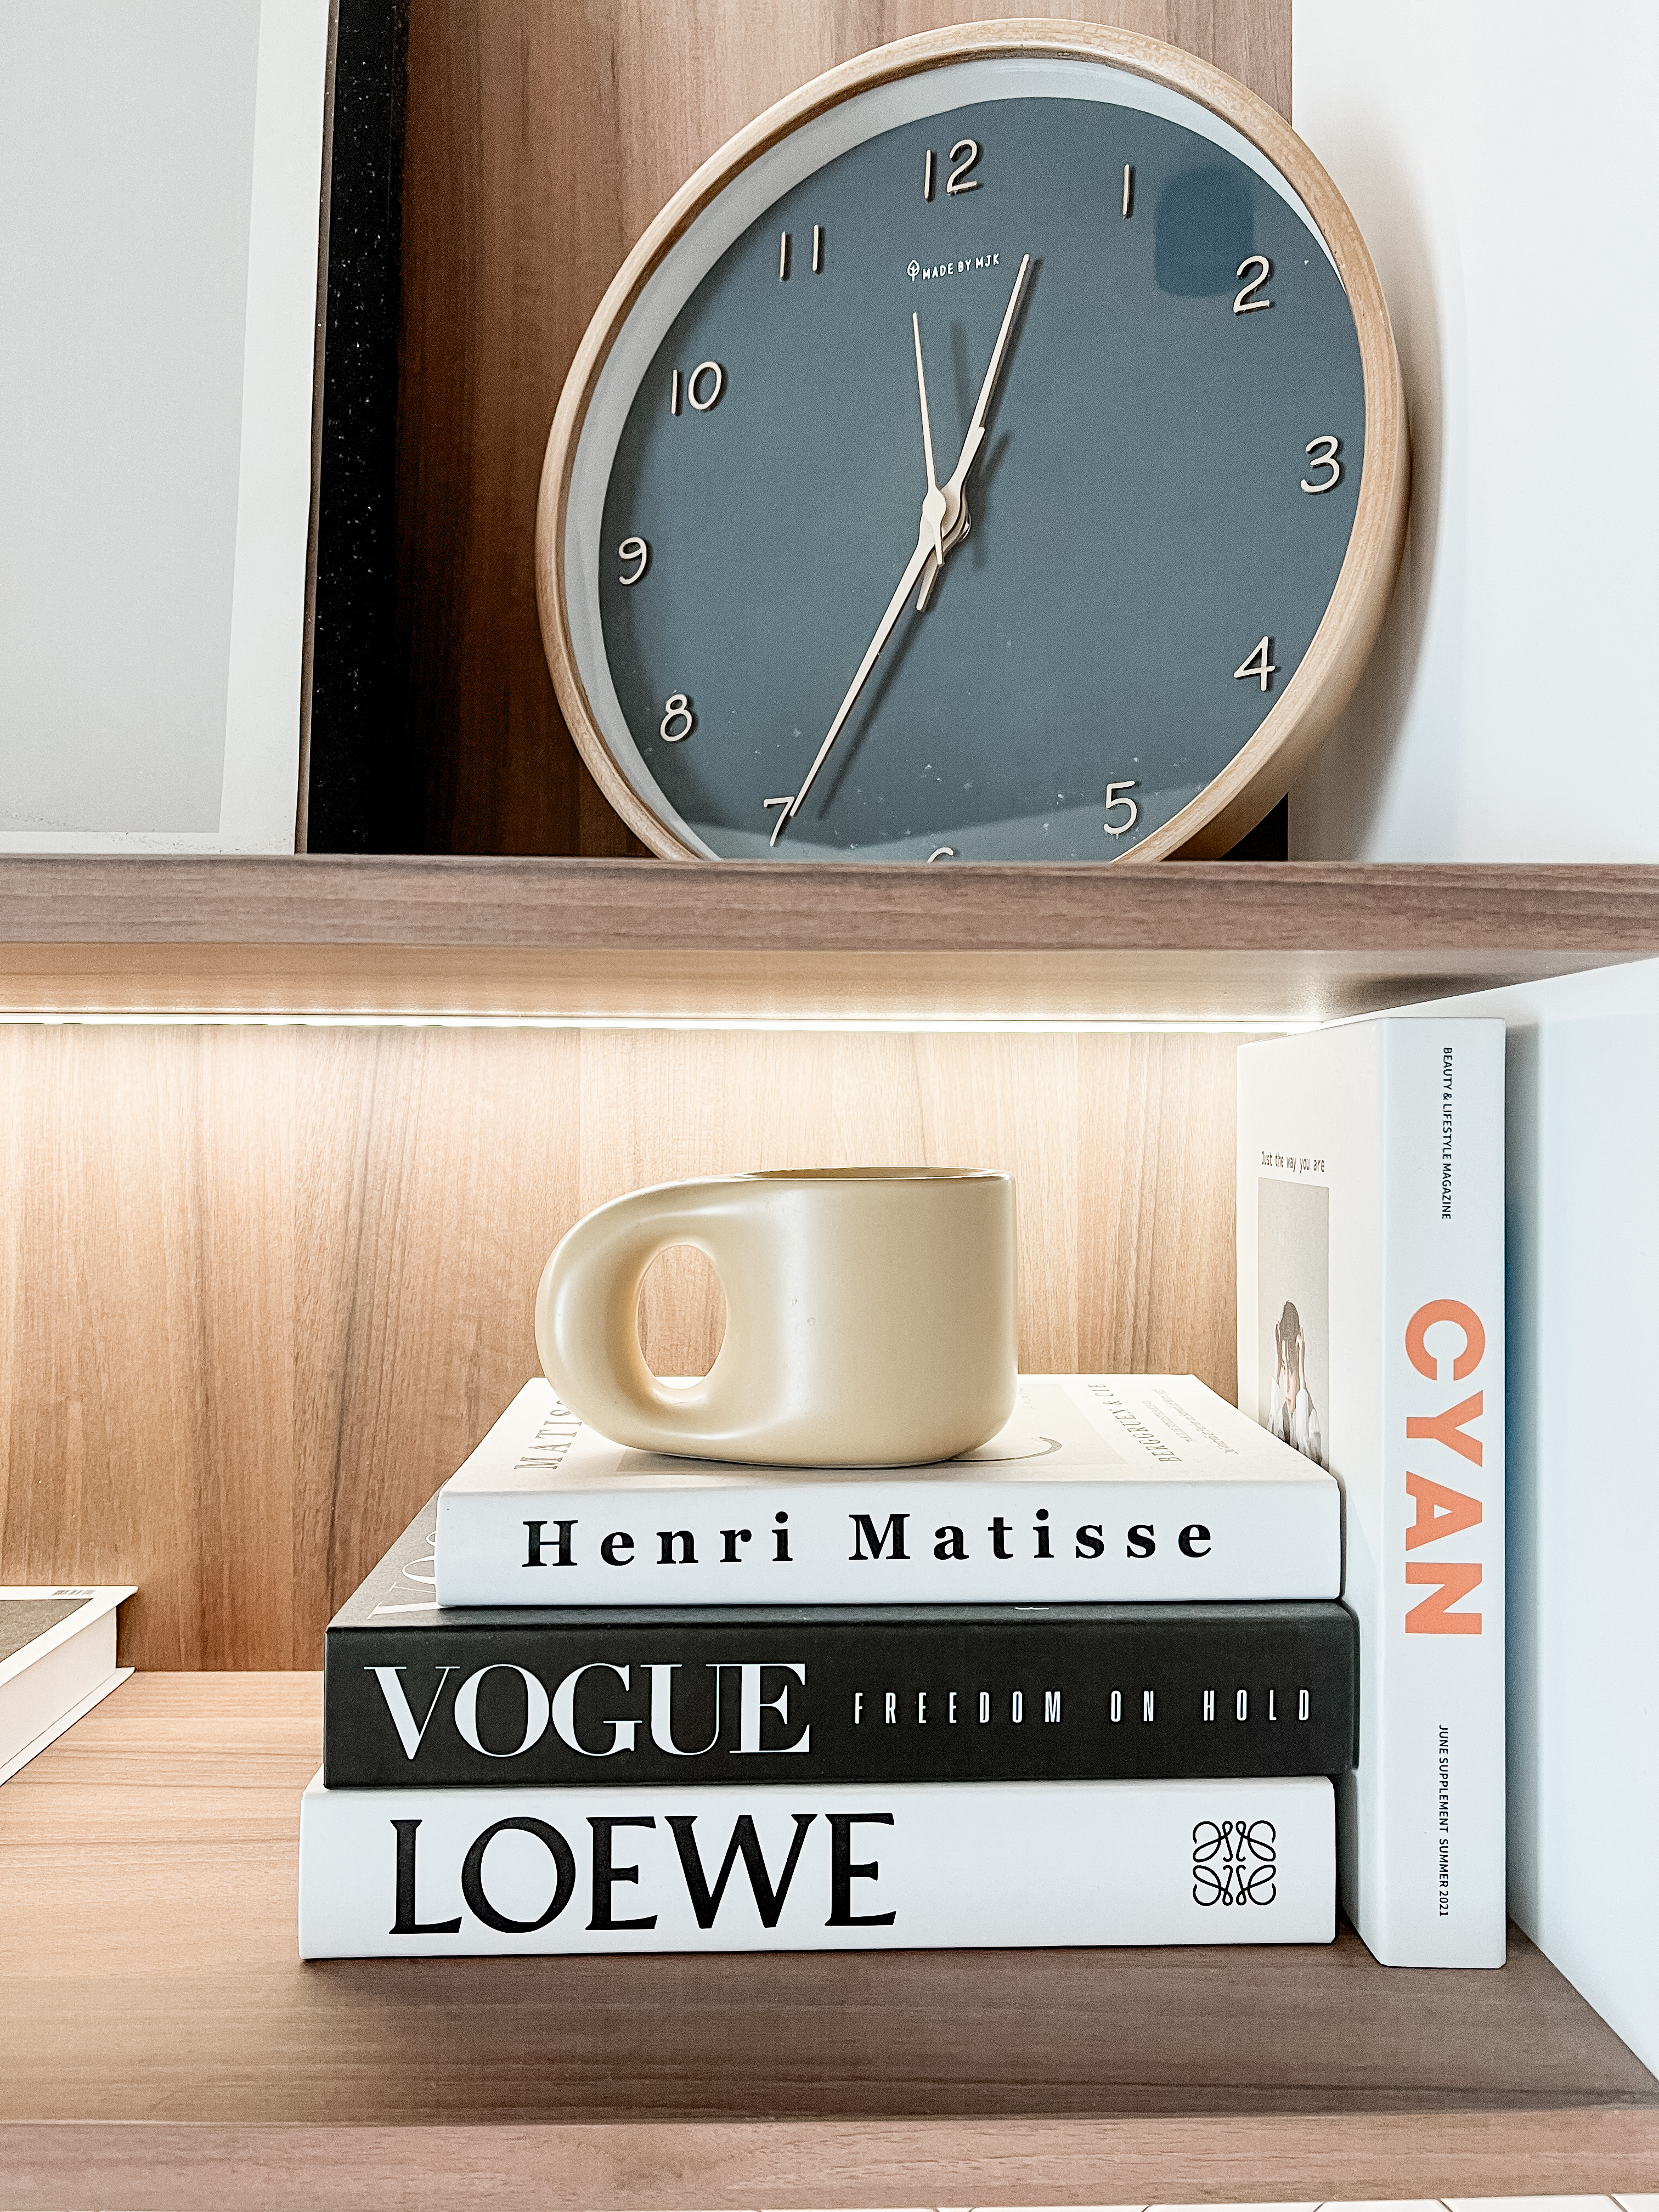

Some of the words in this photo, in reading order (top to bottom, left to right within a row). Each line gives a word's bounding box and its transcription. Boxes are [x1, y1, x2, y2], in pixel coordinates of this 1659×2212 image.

[924, 139, 978, 199] 12
[1122, 163, 1131, 216] 1
[780, 224, 819, 279] 11
[922, 262, 954, 280] MADE
[957, 258, 972, 273] BY
[975, 252, 1000, 269] MJK
[1233, 255, 1271, 314] 2
[671, 360, 723, 415] 10
[1300, 435, 1341, 494] 3
[618, 537, 647, 585] 9
[1233, 635, 1276, 692] 4
[660, 693, 693, 742] 8
[763, 795, 795, 847] 7
[1103, 780, 1138, 835] 5
[1443, 1047, 1453, 1090] BEAUTY
[1443, 1092, 1453, 1101] &
[1442, 1103, 1453, 1160] LIFESTYLE
[1261, 1151, 1272, 1166] Just
[1275, 1152, 1284, 1168] the
[1286, 1156, 1297, 1173] way
[1299, 1158, 1311, 1174] you
[1313, 1159, 1325, 1172] are
[1442, 1163, 1452, 1220] MAGAZINE
[1109, 1408, 1182, 1462] BERGGRUEN
[1405, 1299, 1486, 1635] CYAN
[522, 1510, 794, 1568] Henri
[848, 1508, 1212, 1561] Matisse
[363, 1662, 811, 1760] VOGUE
[854, 1691, 1061, 1725] FREEDOM
[1110, 1690, 1154, 1723] ON
[1203, 1689, 1310, 1722] HOLD
[1438, 1724, 1449, 1754] JUNE
[1438, 1757, 1449, 1833] SUPPLEMENT
[388, 1812, 897, 1935] LOEWE
[1438, 1838, 1449, 1888] SUMMER
[1438, 1890, 1449, 1917] 2021
